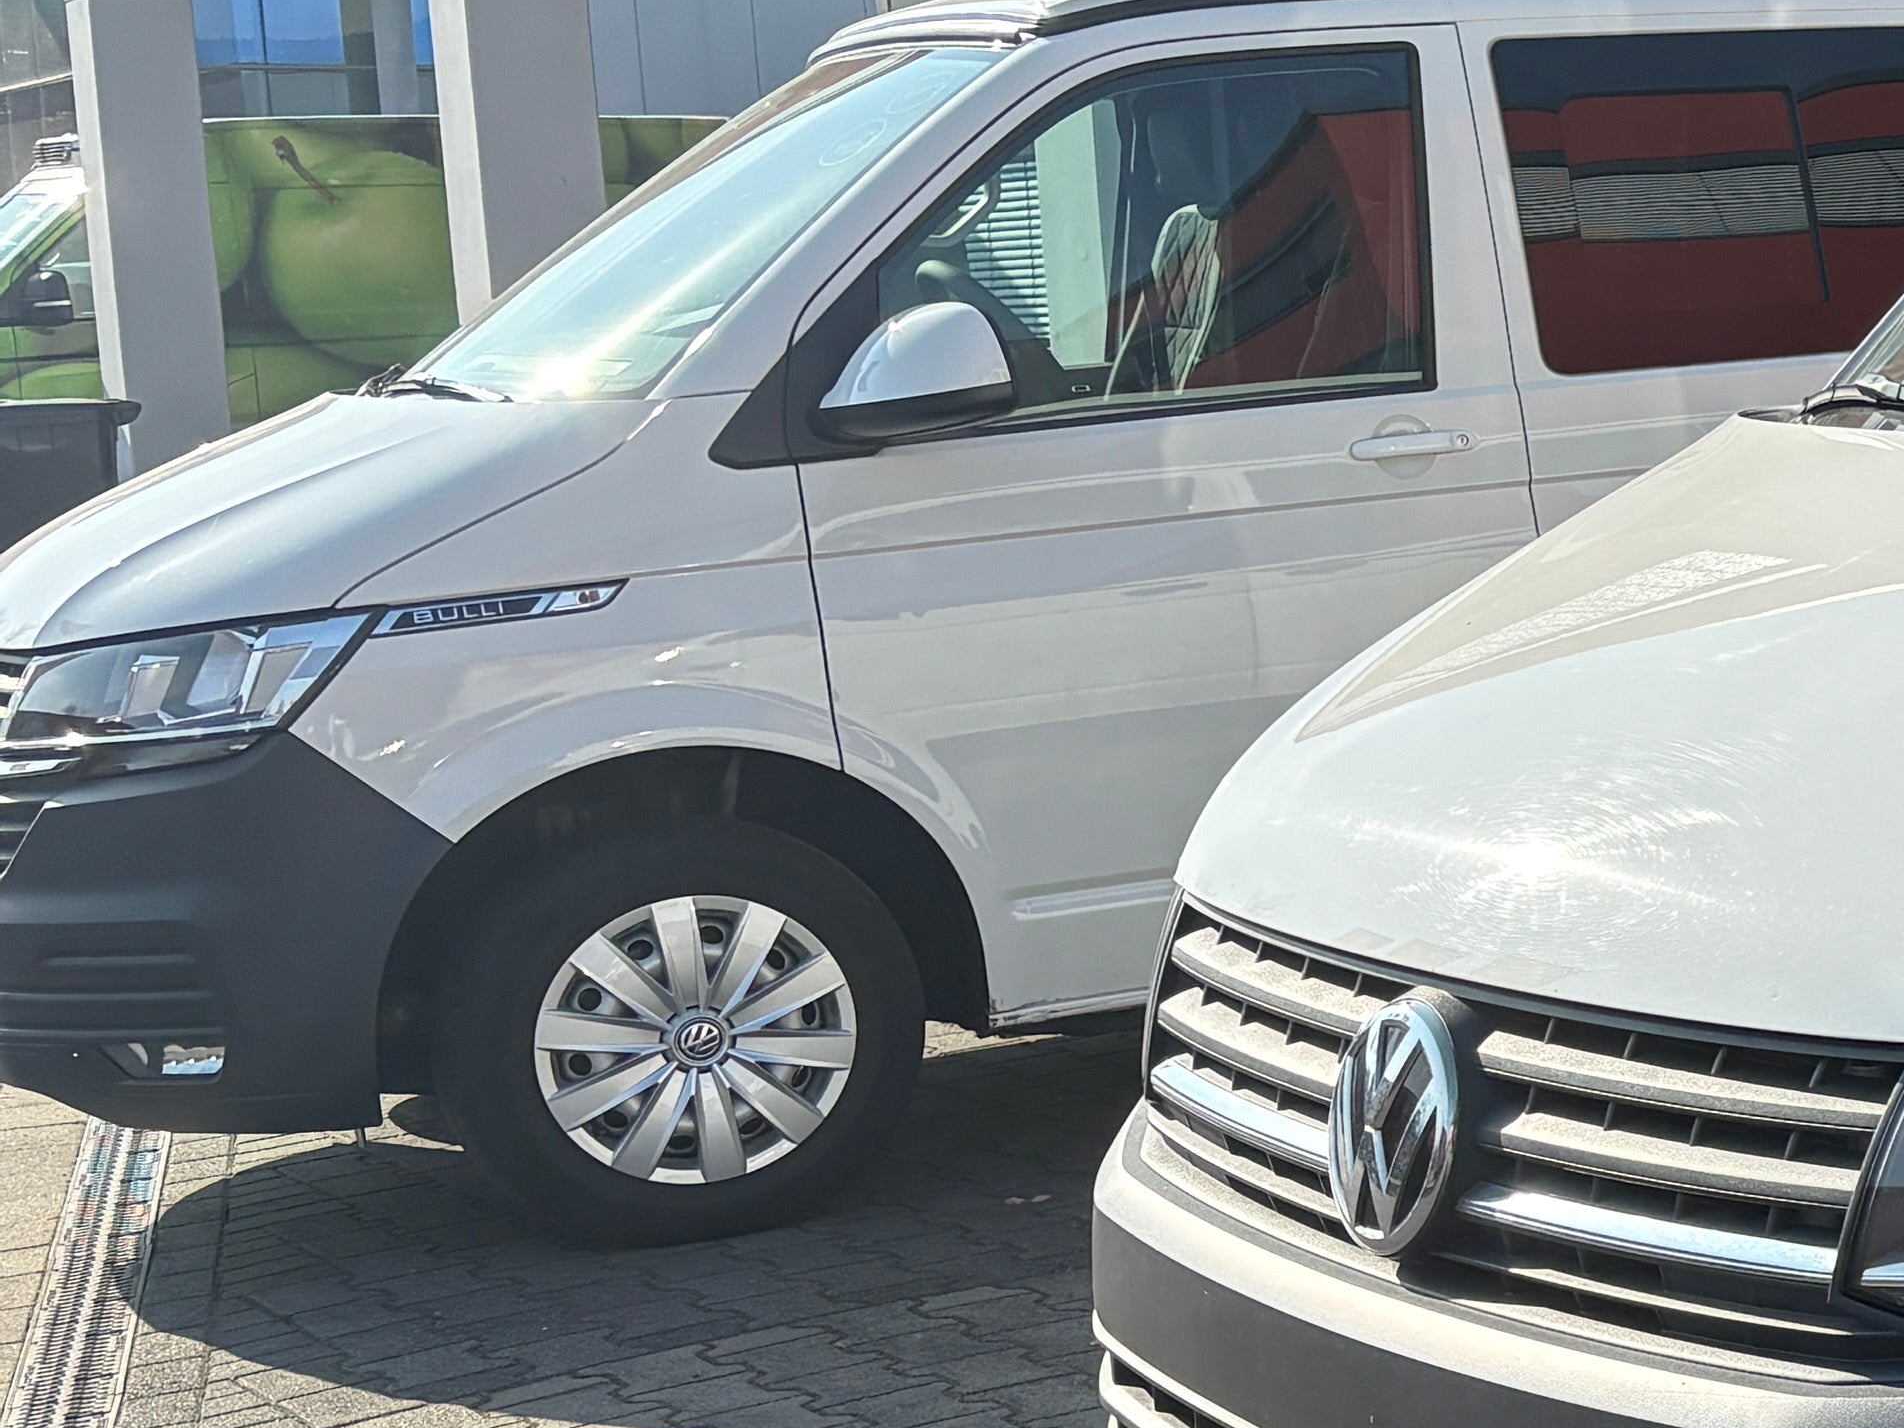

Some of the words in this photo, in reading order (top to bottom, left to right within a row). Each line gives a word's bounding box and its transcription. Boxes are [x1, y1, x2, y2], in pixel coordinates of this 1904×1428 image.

[413, 601, 504, 624] BULLI
[677, 1019, 725, 1063] VW
[1328, 998, 1458, 1255] VW
